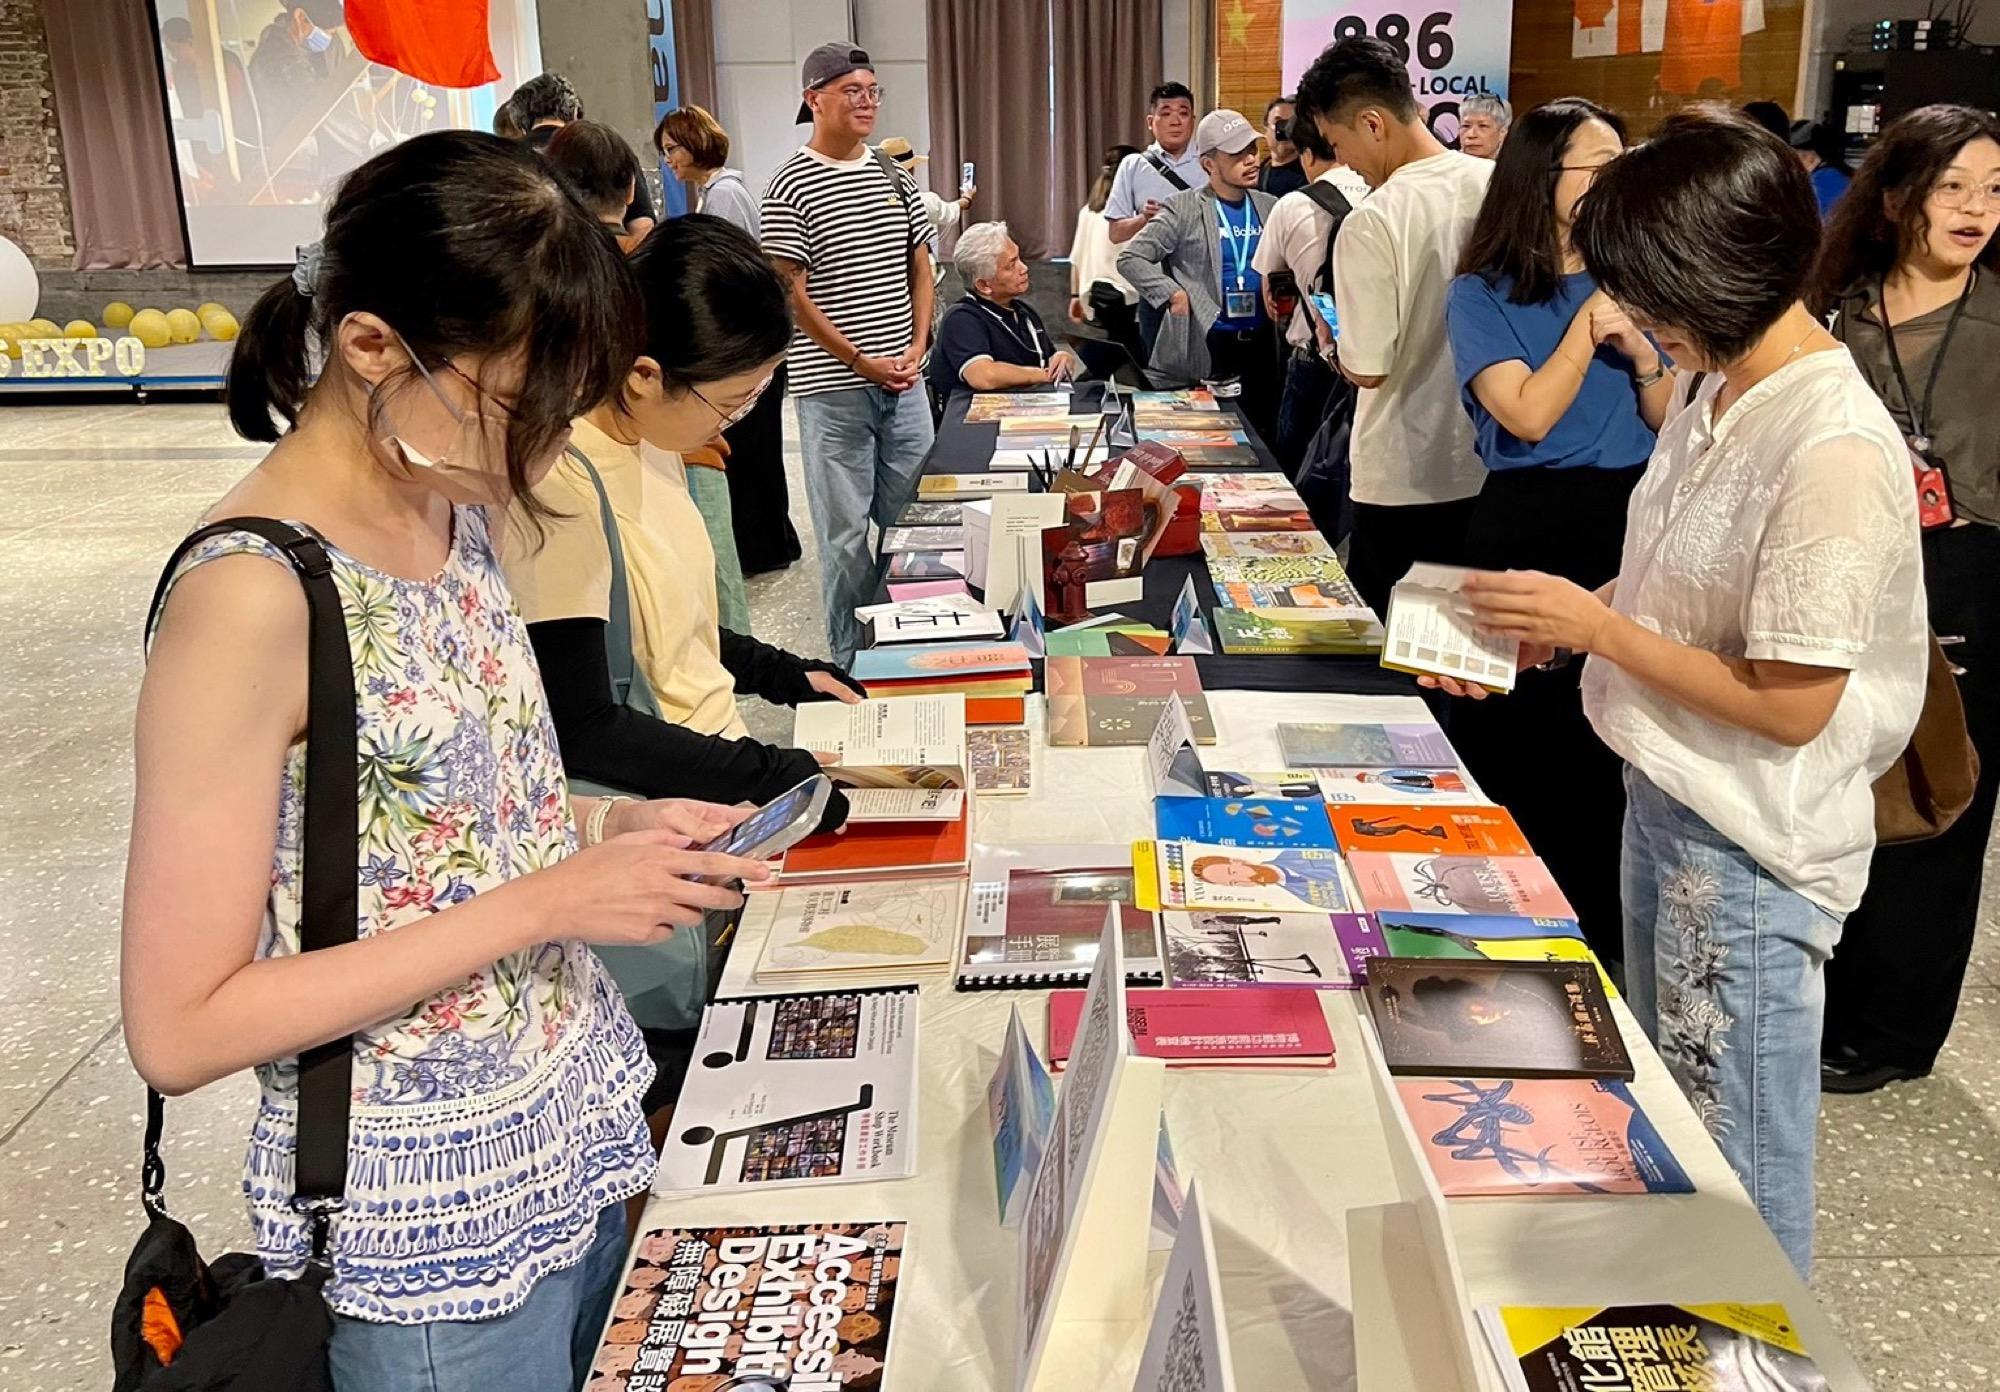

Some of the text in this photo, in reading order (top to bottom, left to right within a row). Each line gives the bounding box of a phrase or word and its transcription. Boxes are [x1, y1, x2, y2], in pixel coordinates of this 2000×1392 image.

[18, 336, 146, 377] EXPO
[1007, 936, 1032, 961] 手冊
[1035, 934, 1060, 961] 展覽
[870, 1129, 885, 1169] Workbook
[885, 1110, 900, 1156] The Museum
[679, 1236, 765, 1375] Design
